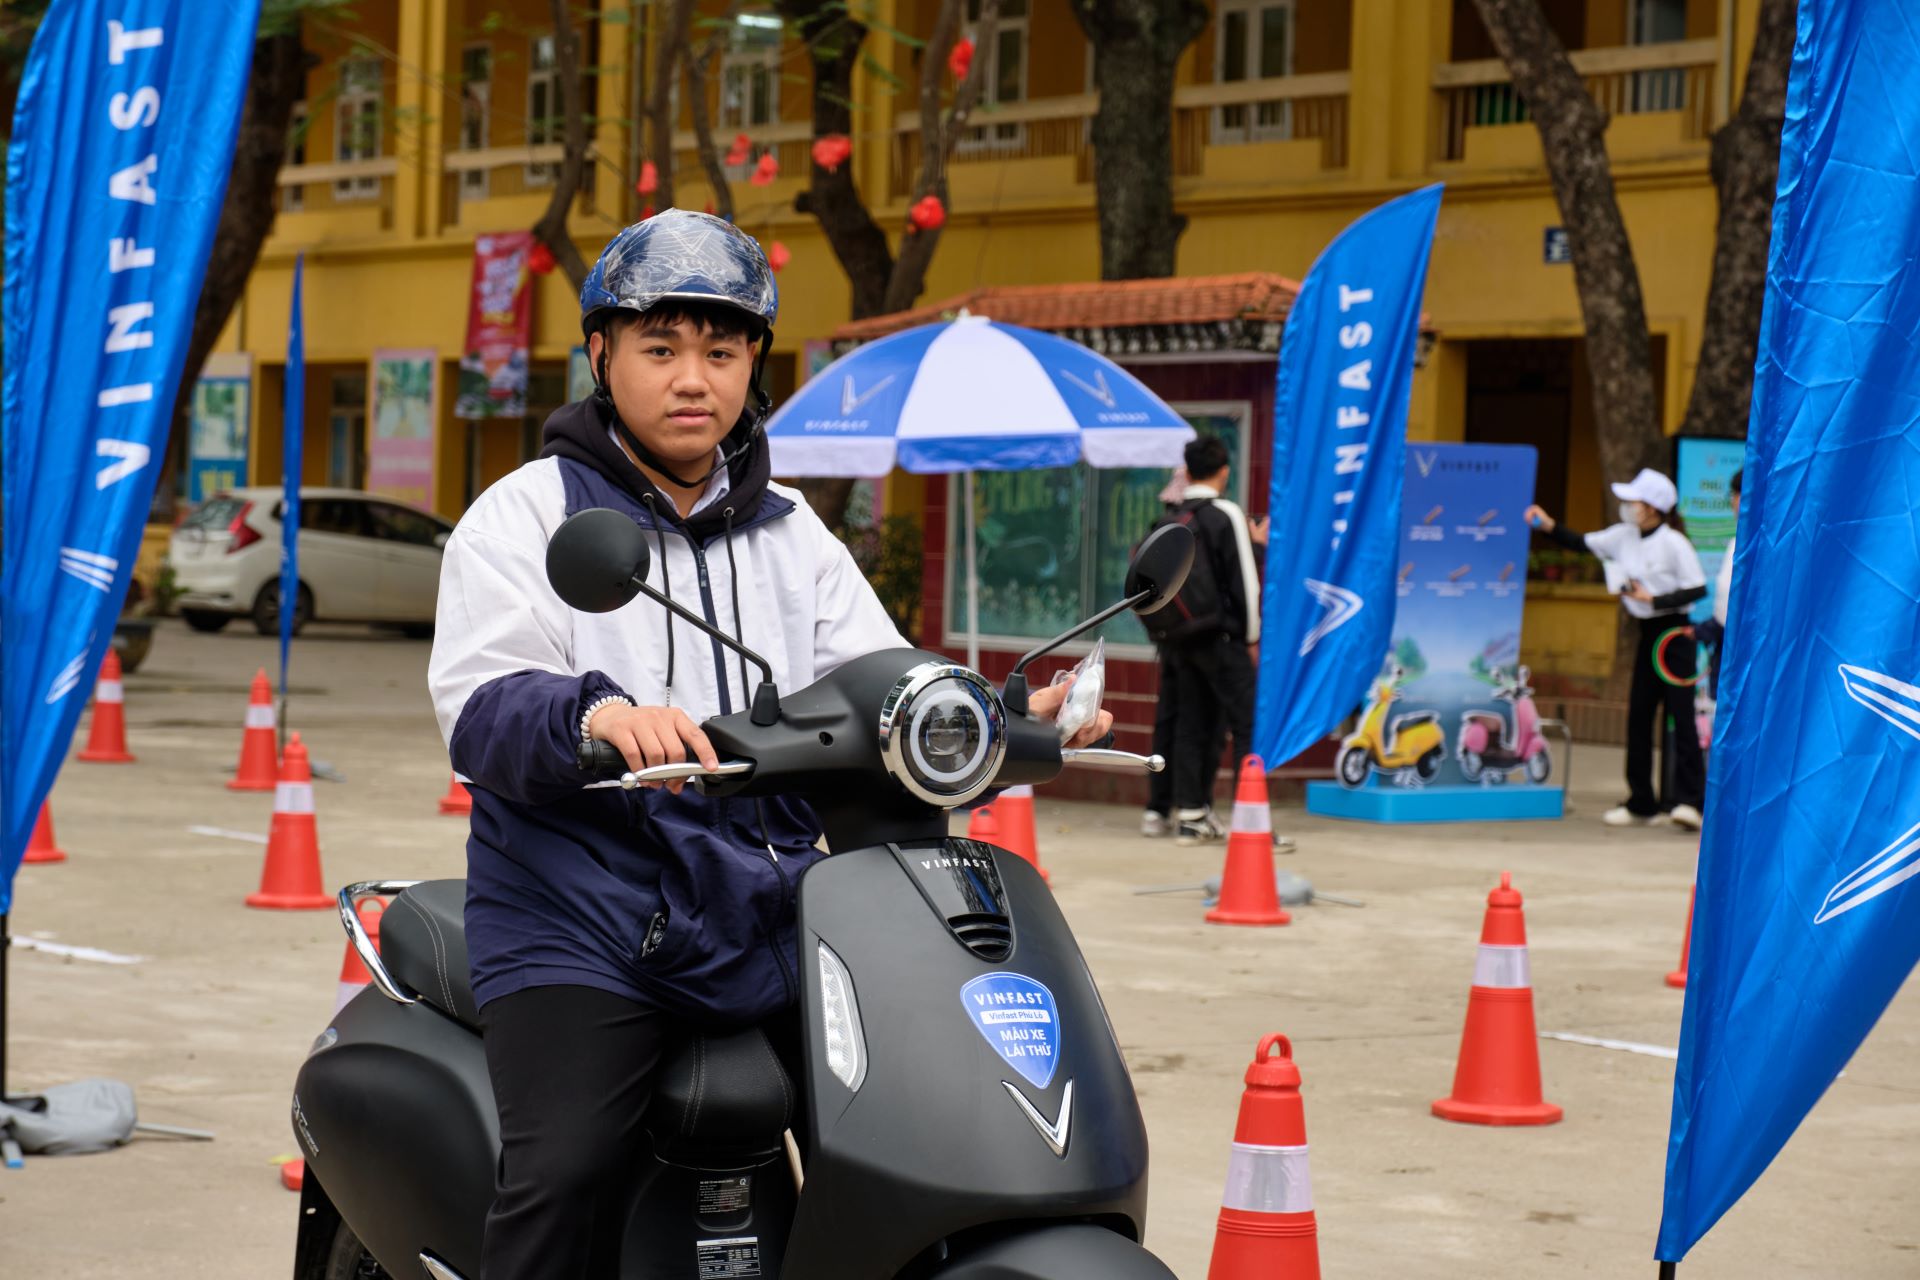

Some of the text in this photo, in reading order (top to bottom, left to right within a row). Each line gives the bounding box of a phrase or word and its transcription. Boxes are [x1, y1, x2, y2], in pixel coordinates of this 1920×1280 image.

[96, 19, 164, 491] VINFAST
[921, 857, 988, 870] VINFAST
[974, 991, 1044, 1006] VINFAST
[988, 1011, 1018, 1020] Vinfast
[1030, 1029, 1047, 1041] XE
[1004, 1042, 1052, 1058] LÁI THỬ
